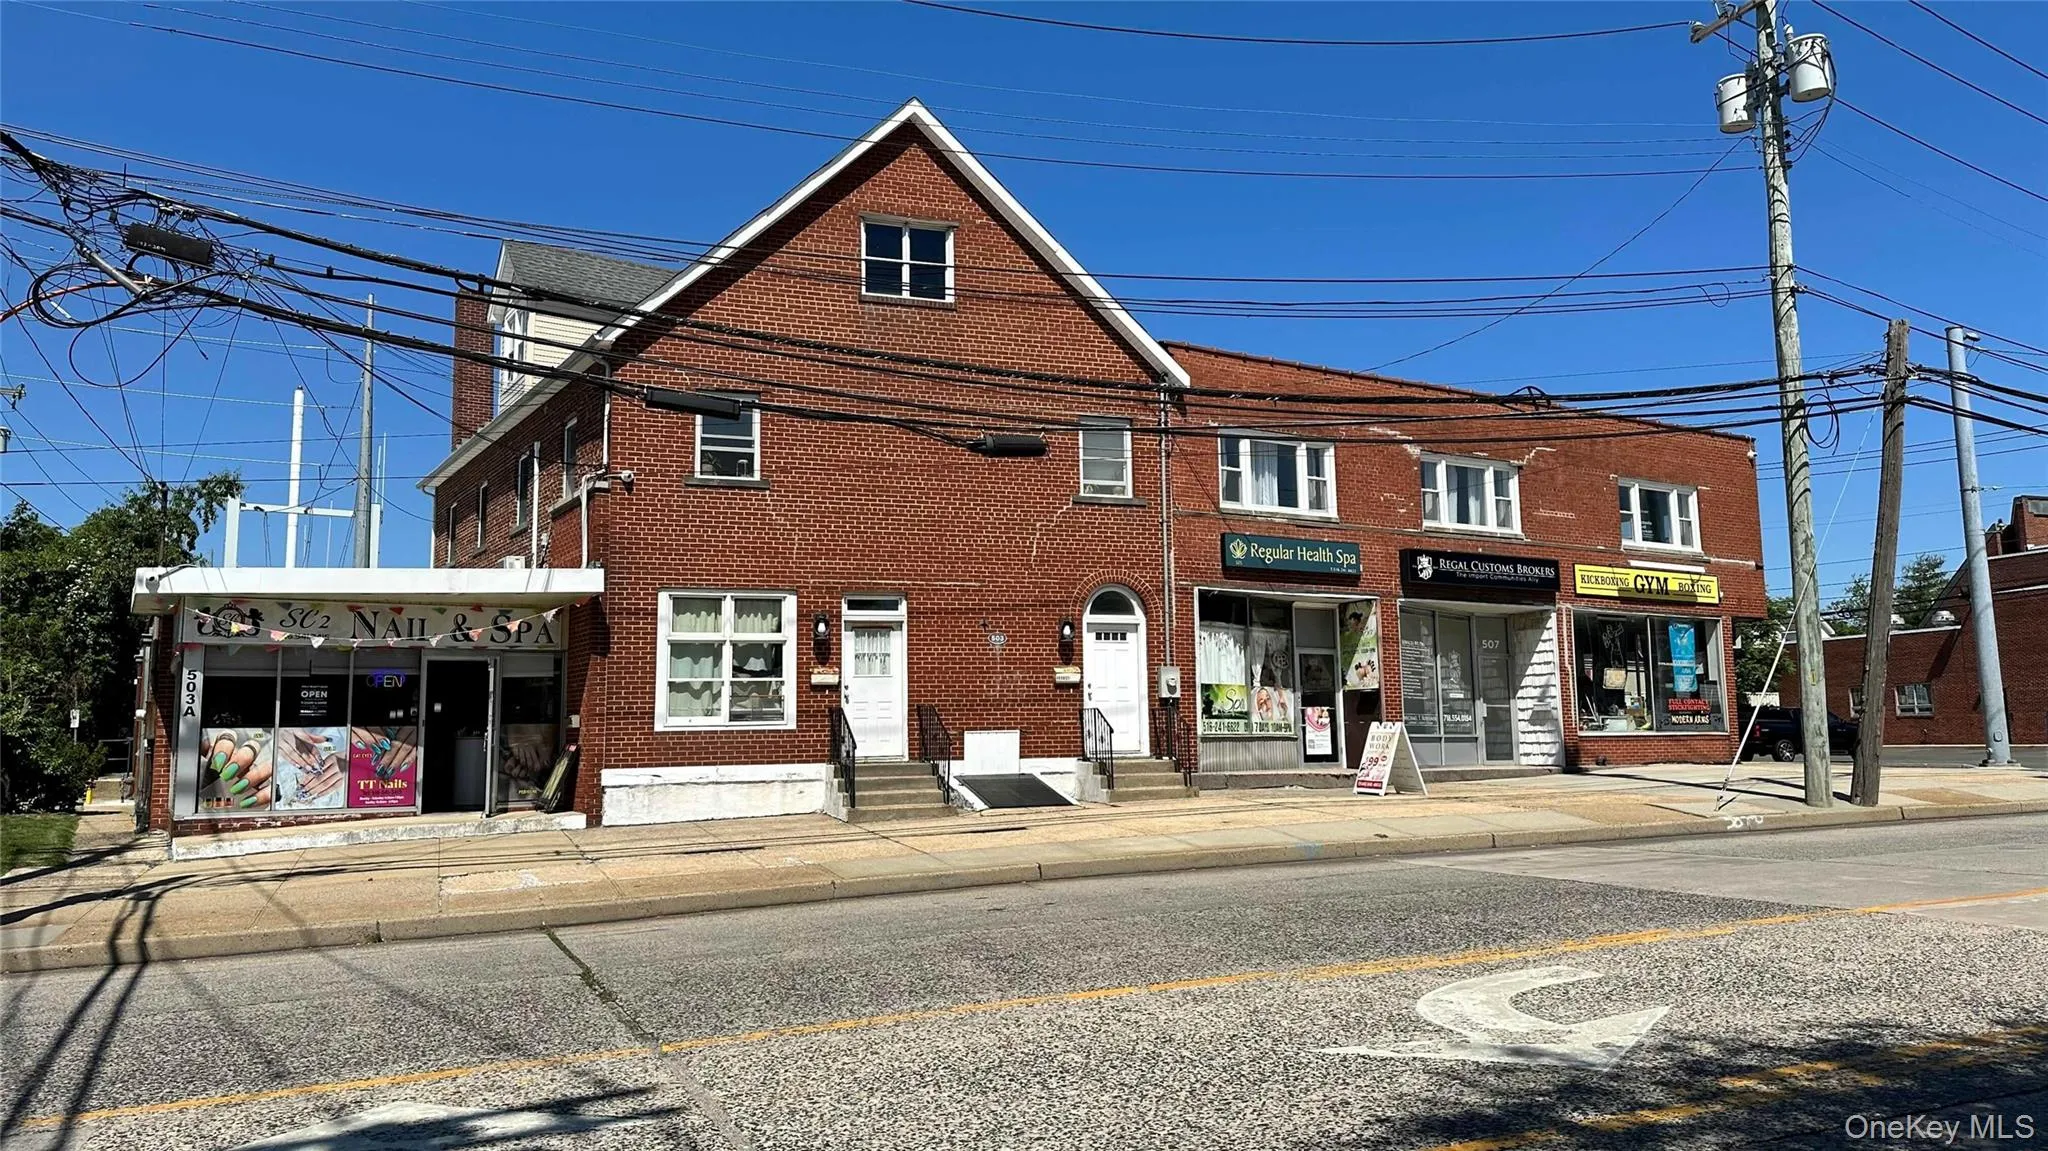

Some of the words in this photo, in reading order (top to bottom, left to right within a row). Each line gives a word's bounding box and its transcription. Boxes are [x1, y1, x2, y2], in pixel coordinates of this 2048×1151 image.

[1250, 543, 1294, 564] Regular
[1297, 546, 1333, 562] Health
[1336, 549, 1356, 568] Spa
[1439, 558, 1467, 570] REGAL
[1470, 560, 1514, 573] CUSTOMS
[1516, 563, 1555, 576] BROKERS
[1580, 574, 1629, 587] KICKBOXING
[1633, 574, 1670, 595] GYM
[1678, 582, 1711, 594] BOXING
[350, 610, 429, 641] NAIL
[450, 613, 475, 643] &
[490, 613, 554, 644] SPA
[1482, 639, 1500, 649] 507
[183, 669, 197, 717] 503A
[301, 690, 328, 698] OPEN
[357, 780, 376, 789] TT
[379, 779, 408, 789] Nails
